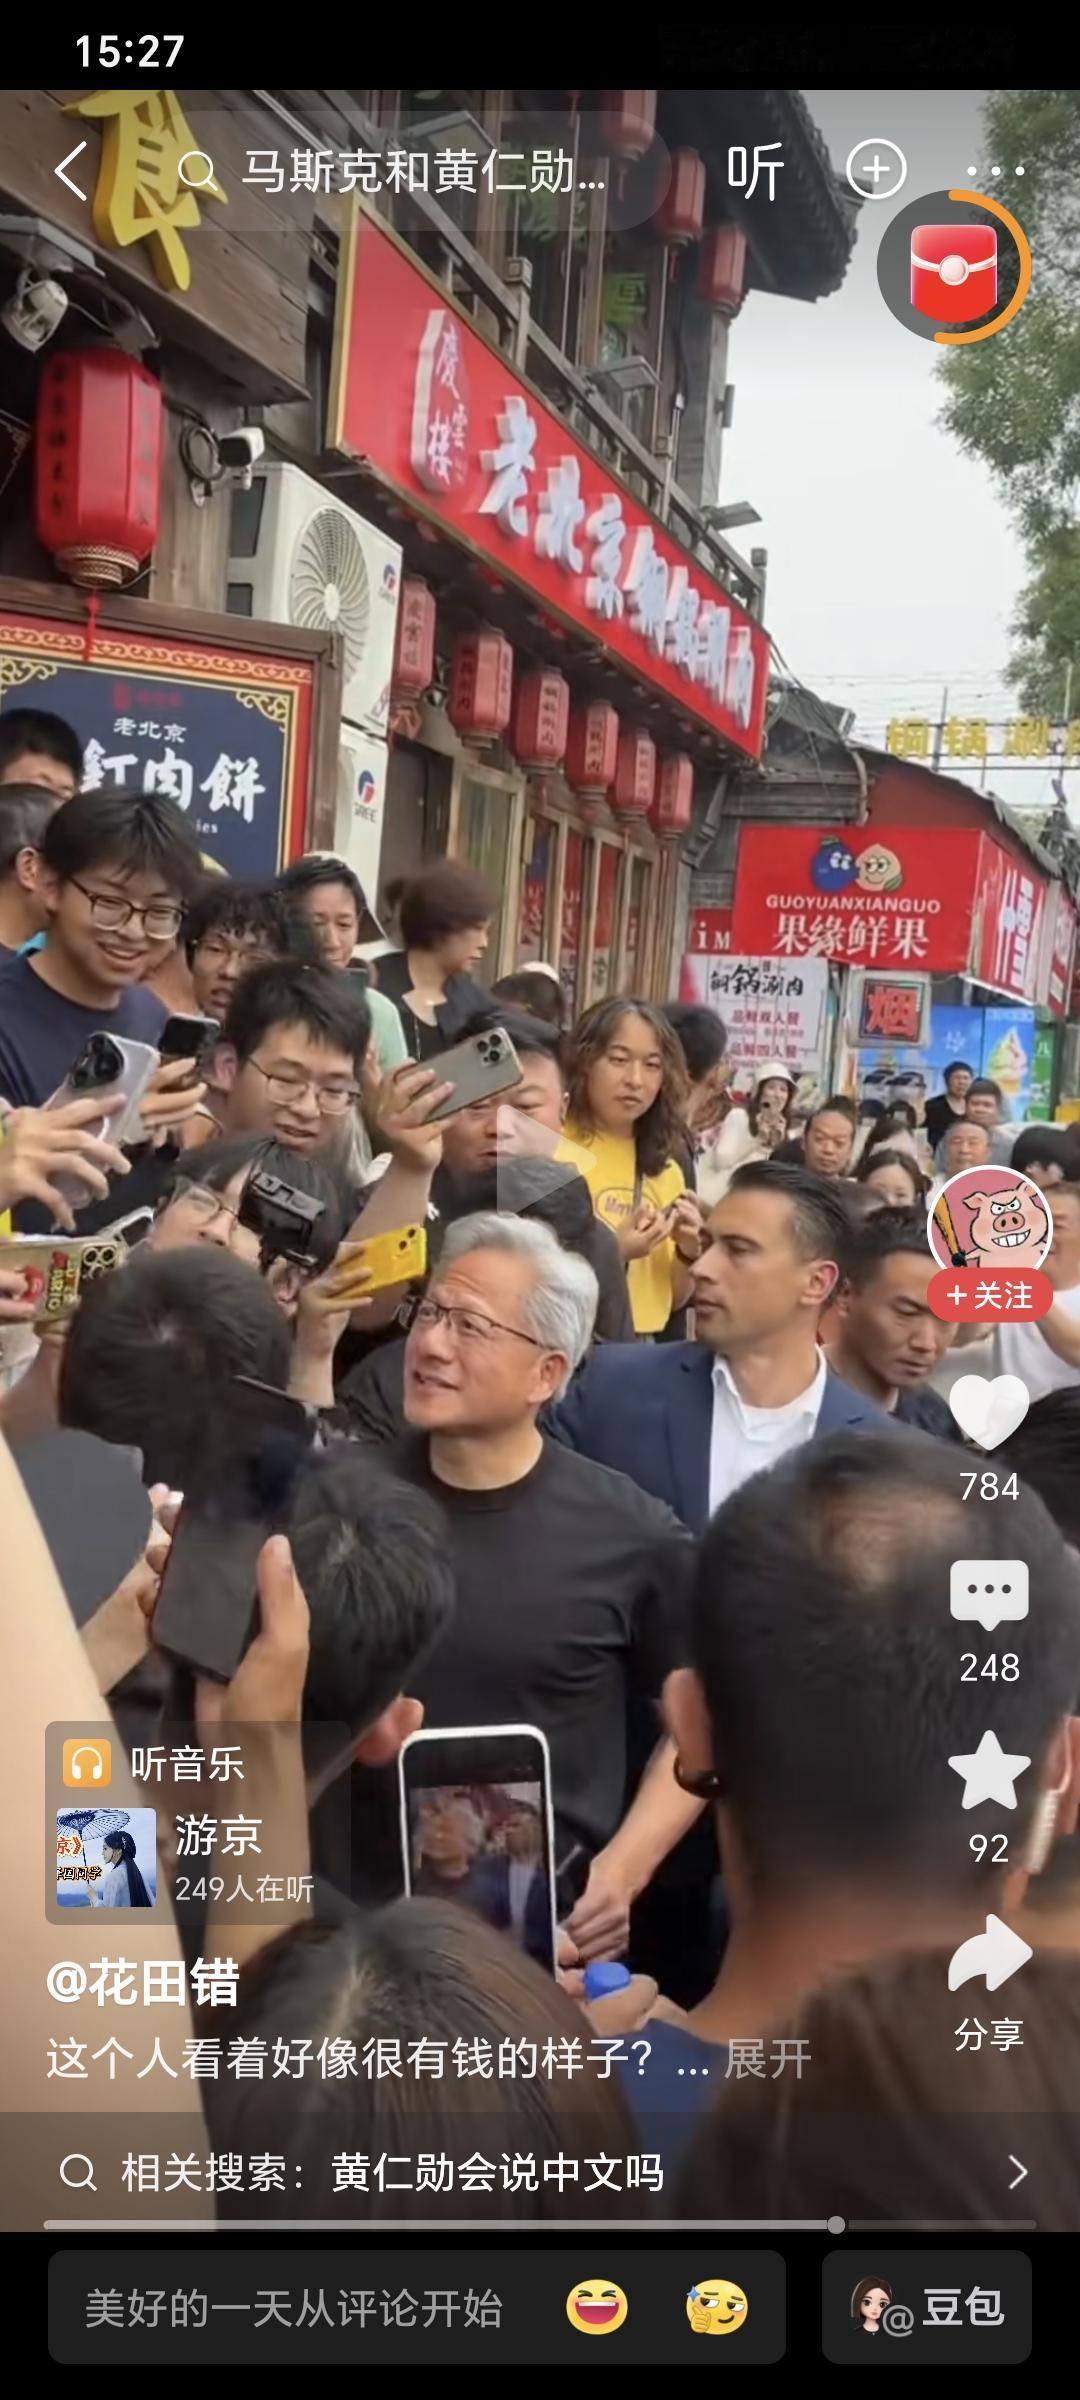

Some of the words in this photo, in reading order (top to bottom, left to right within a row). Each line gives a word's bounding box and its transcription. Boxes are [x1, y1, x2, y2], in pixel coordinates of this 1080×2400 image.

[113, 717, 187, 743] 老北京
[766, 894, 941, 914] GUOYUANXIANGUO
[773, 913, 929, 960] 果缘鲜果
[867, 986, 918, 1037] 烟
